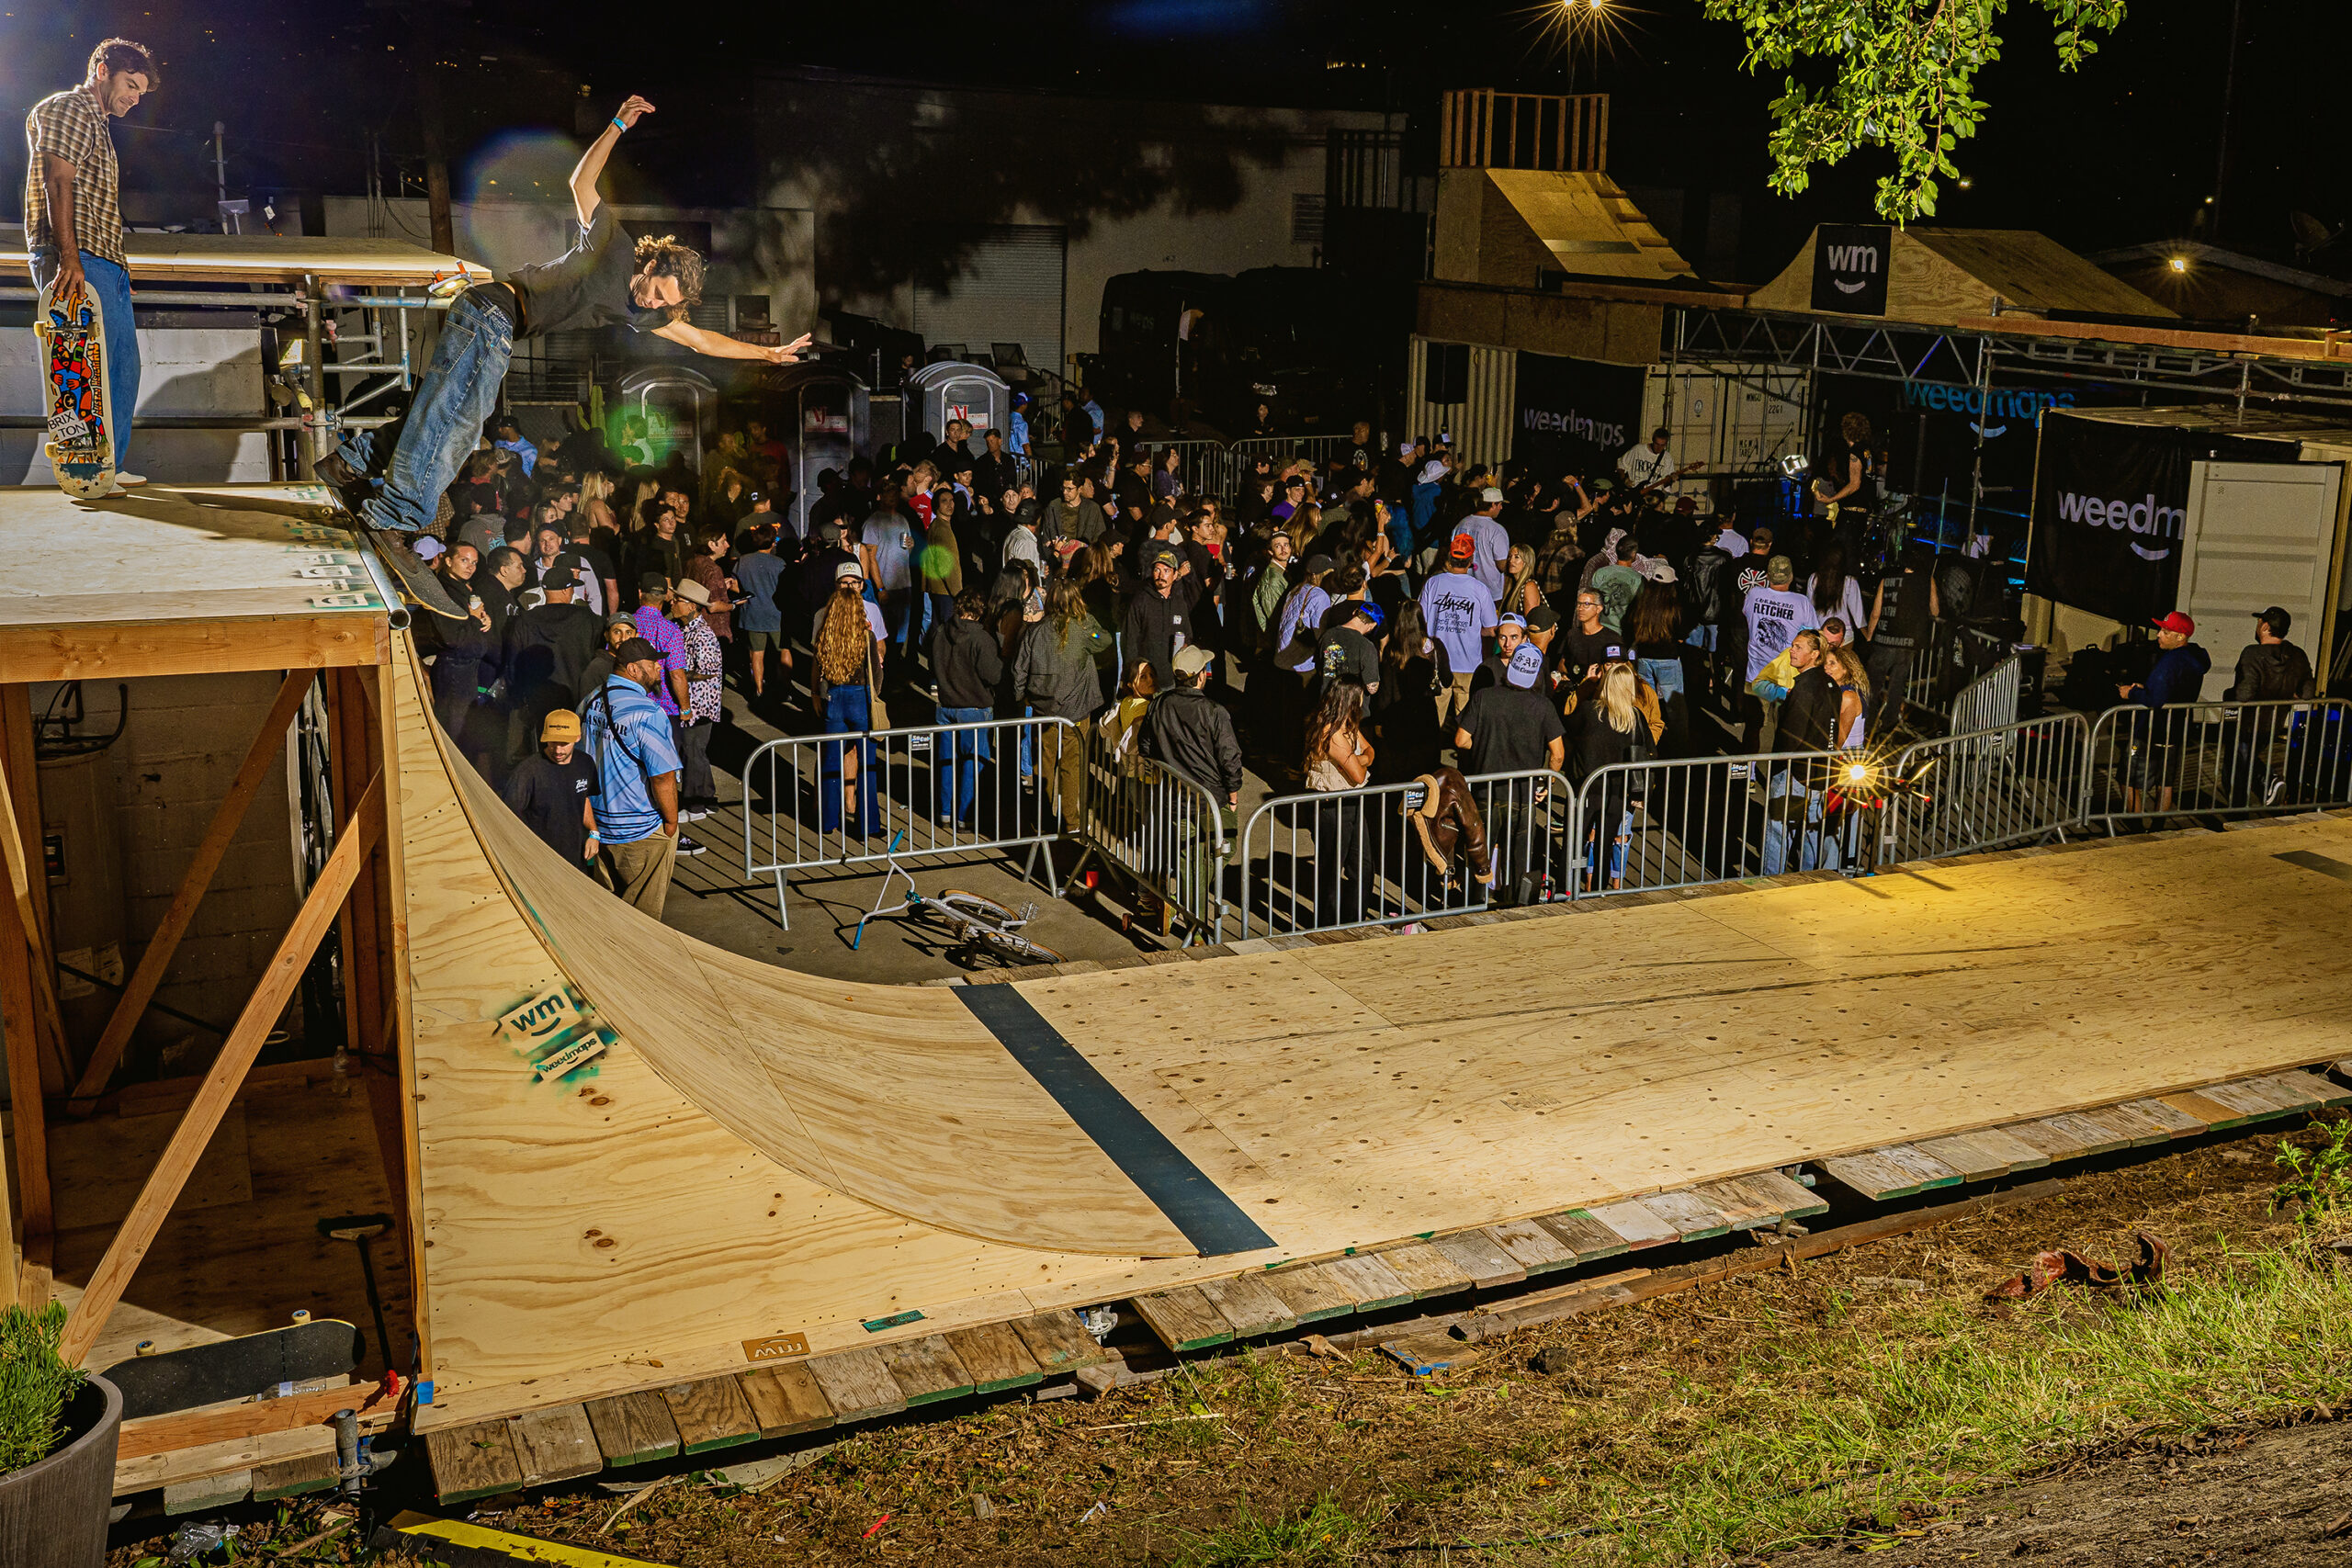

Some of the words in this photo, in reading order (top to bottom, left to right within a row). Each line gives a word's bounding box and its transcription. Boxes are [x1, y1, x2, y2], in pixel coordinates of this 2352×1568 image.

[1827, 245, 1877, 273] wm
[48, 412, 75, 430] BRIX
[58, 423, 86, 437] TON
[1524, 408, 1624, 452] weedmaps
[1883, 577, 1904, 587] ON'T
[1753, 603, 1793, 620] FLETCHER
[510, 994, 565, 1032] wm
[542, 1037, 598, 1073] weedmaps
